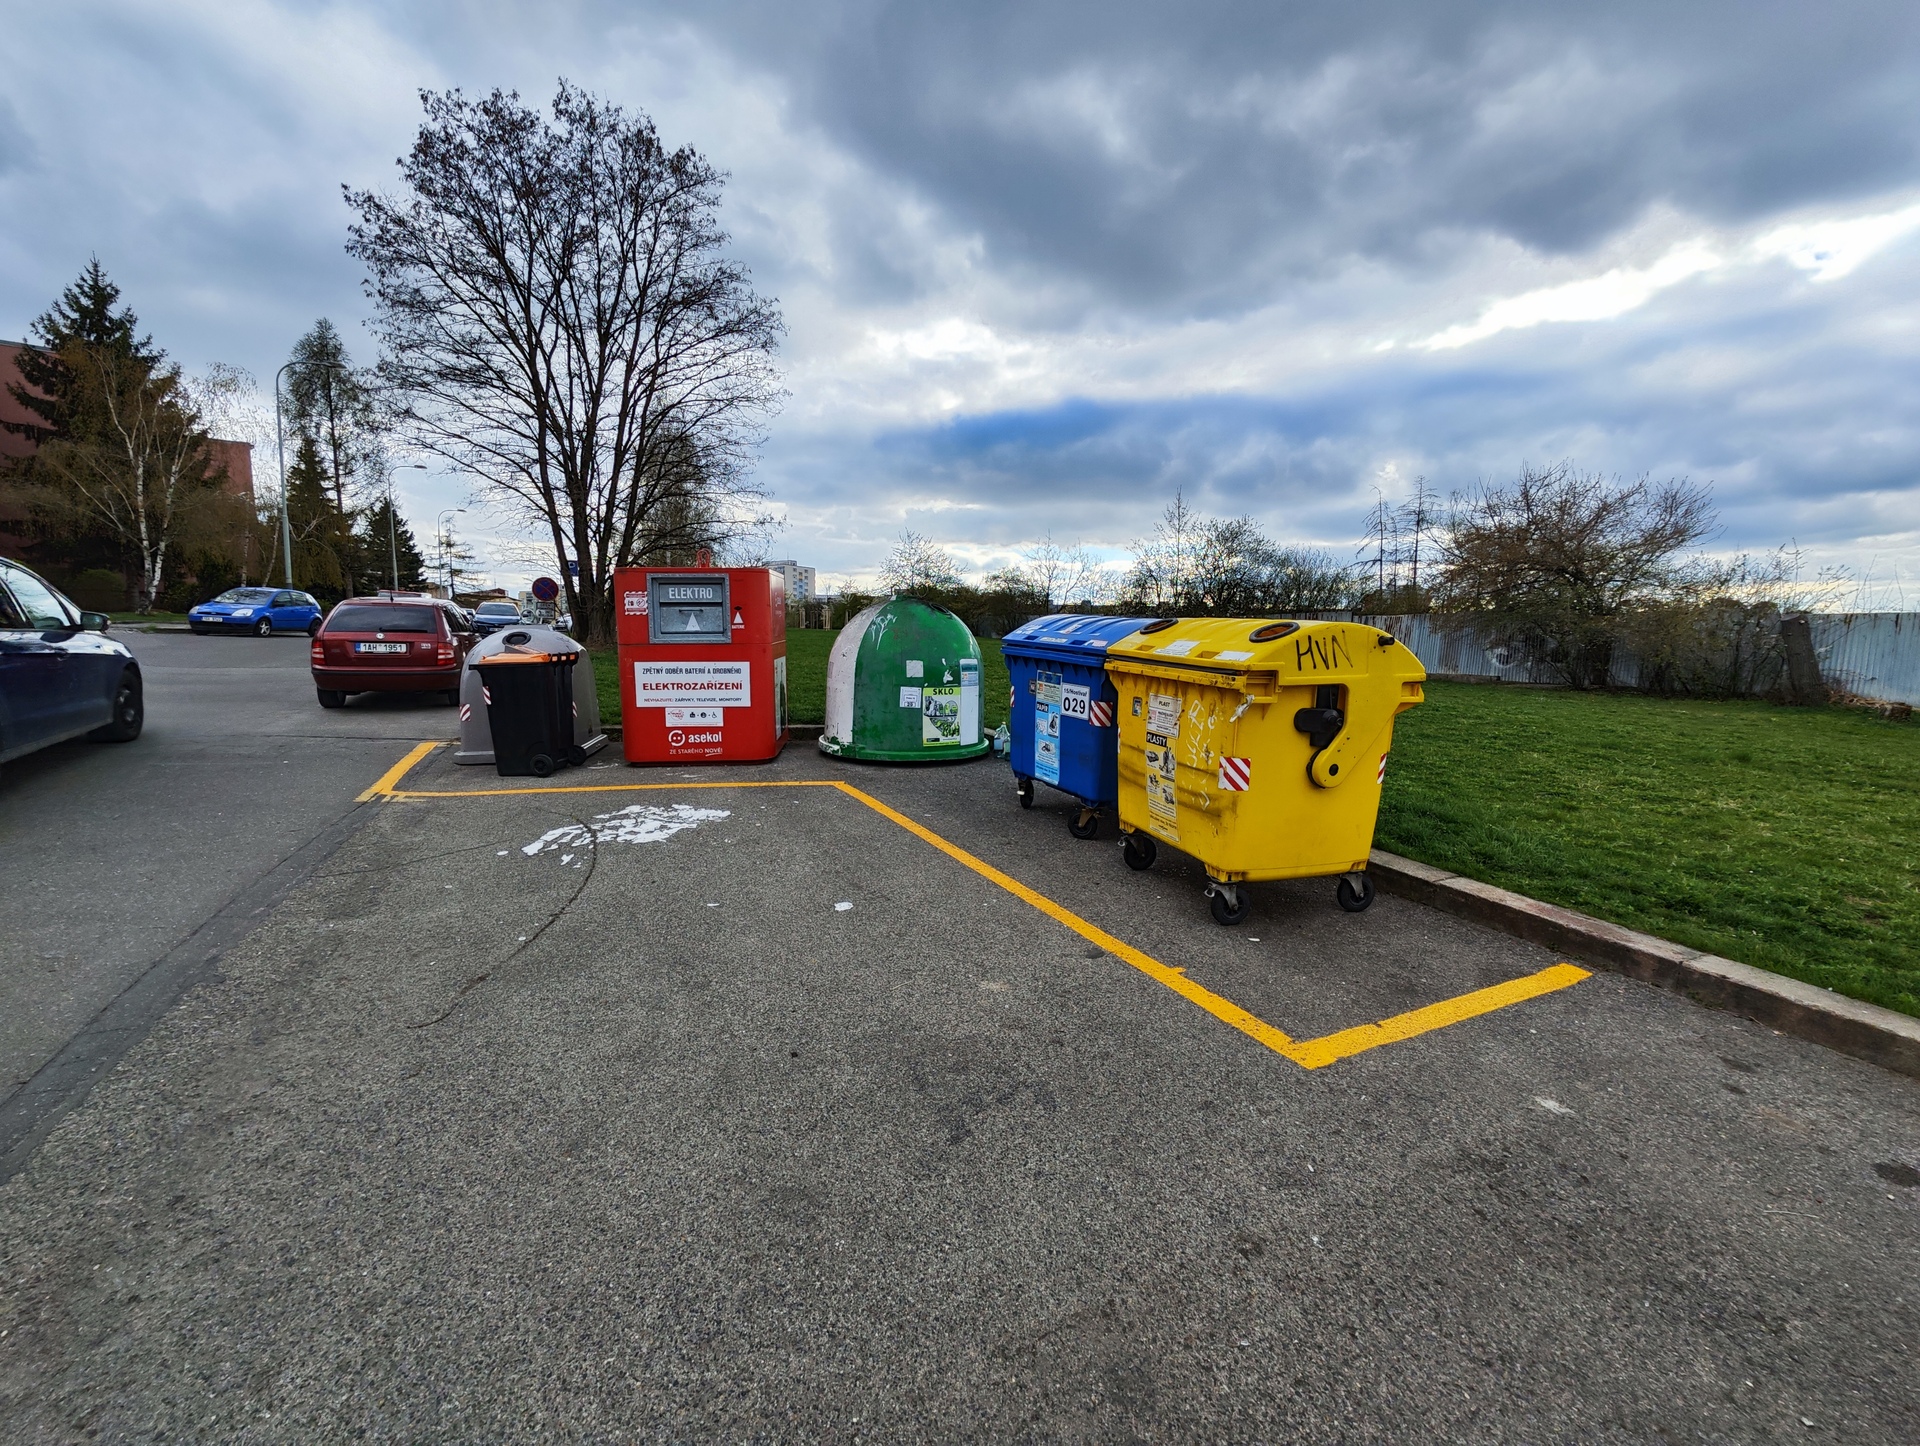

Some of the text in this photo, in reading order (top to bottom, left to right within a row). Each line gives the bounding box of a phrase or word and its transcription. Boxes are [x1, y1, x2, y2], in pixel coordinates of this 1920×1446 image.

[669, 588, 713, 599] ELEKTRO
[363, 643, 378, 651] 1AH
[642, 666, 663, 675] ZPĚTNÝ
[665, 666, 684, 675] ODBĚR
[685, 666, 706, 675] BATERIÍ
[713, 666, 742, 675] DROBNÉHO
[642, 680, 743, 691] ELEKTROZAŘÍZENÍ
[1063, 697, 1086, 715] 029
[688, 731, 722, 743] asekol
[1147, 732, 1167, 746] PLASTY
